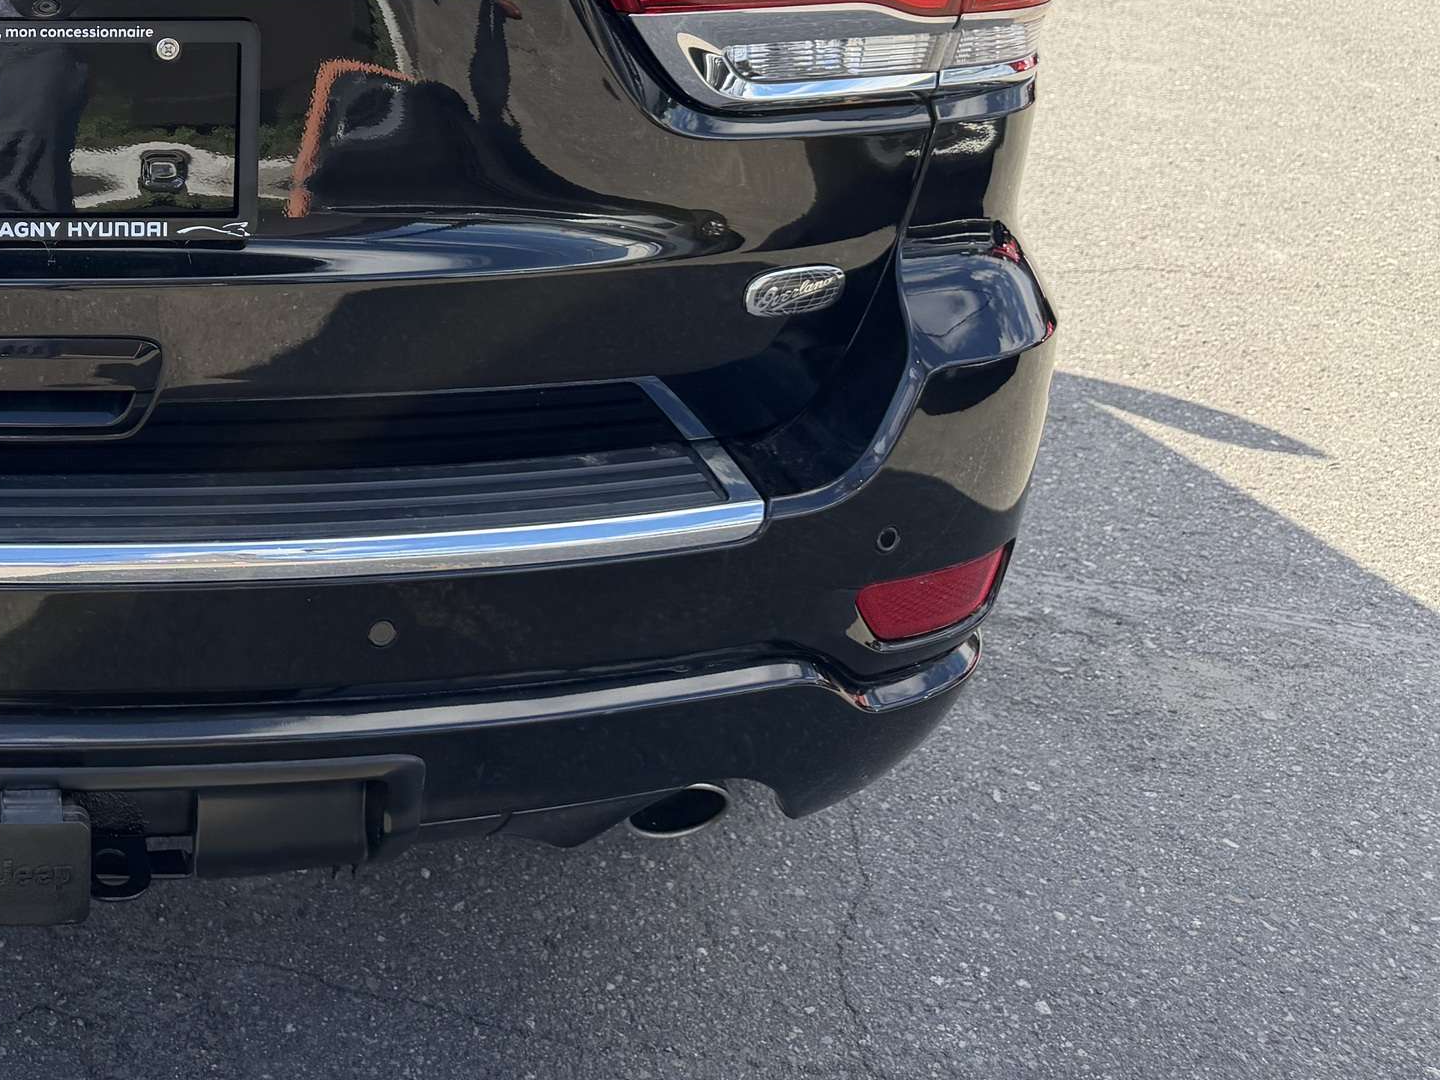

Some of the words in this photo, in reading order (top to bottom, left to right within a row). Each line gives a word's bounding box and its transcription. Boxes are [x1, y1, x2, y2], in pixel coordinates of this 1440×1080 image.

[5, 28, 37, 38] mon
[39, 25, 154, 39] concessionnaire
[67, 221, 168, 238] HYUNDAI
